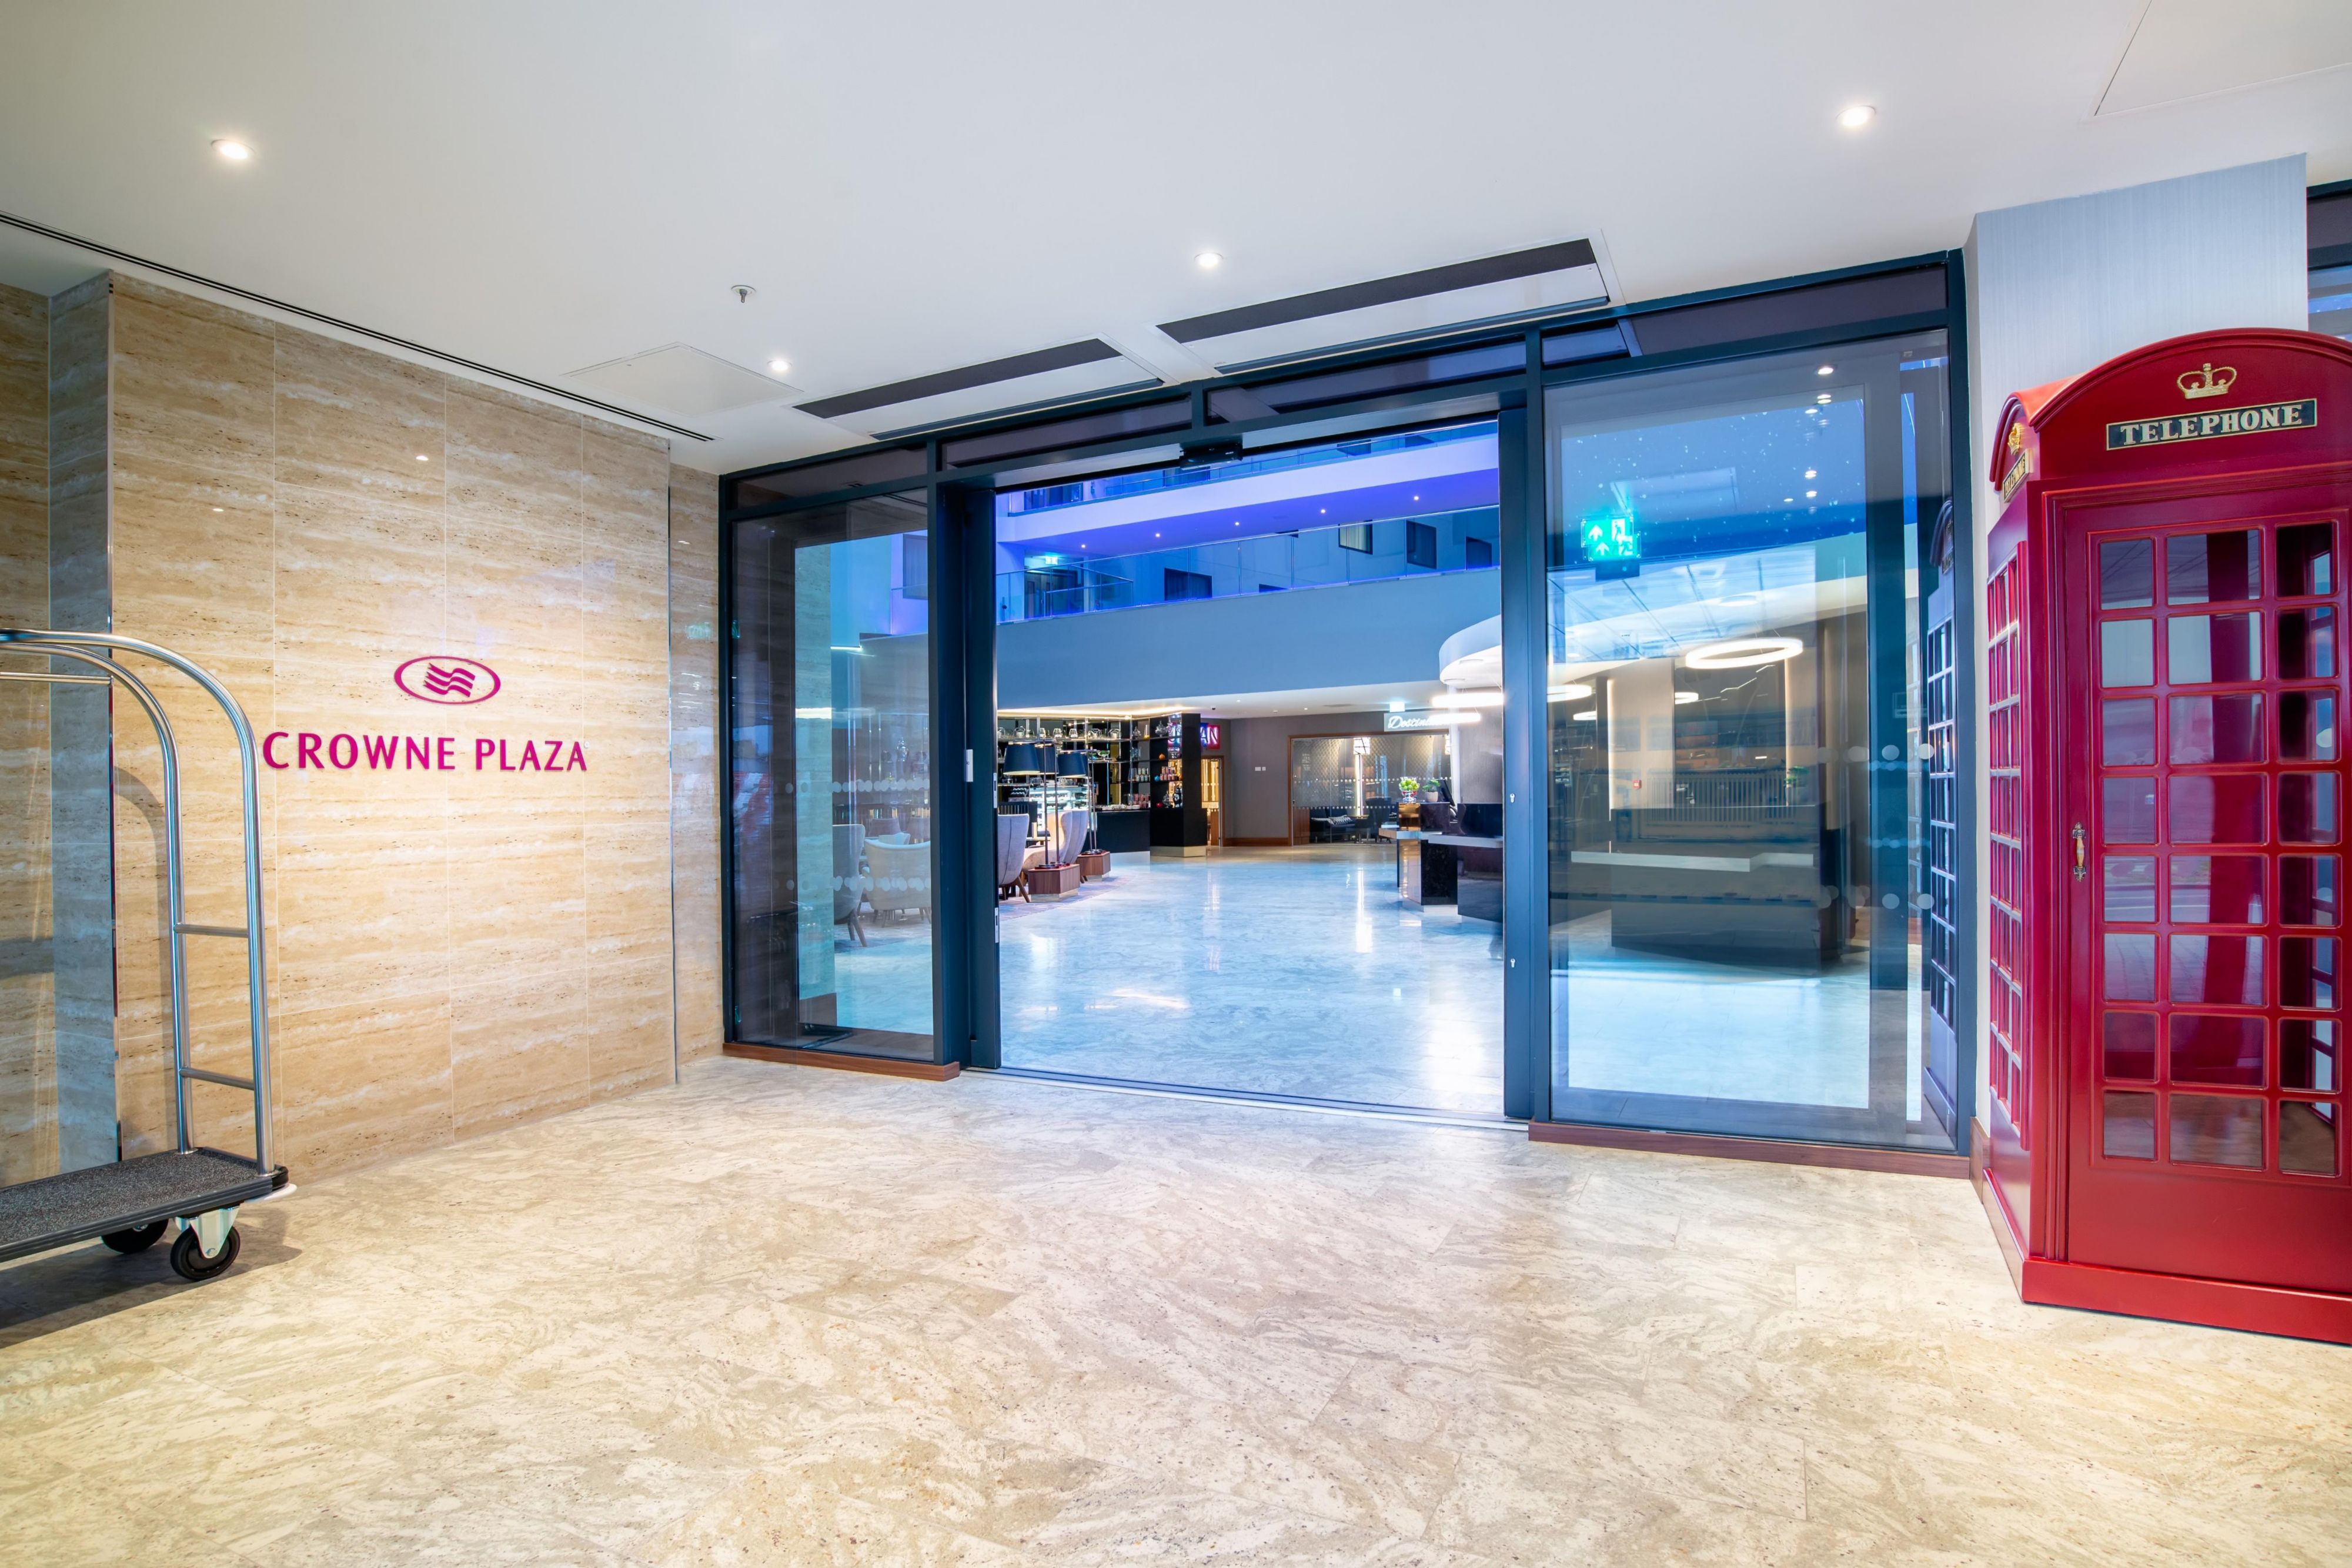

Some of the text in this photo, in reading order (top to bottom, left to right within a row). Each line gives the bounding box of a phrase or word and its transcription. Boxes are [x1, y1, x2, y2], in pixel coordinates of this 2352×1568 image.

[2120, 404, 2303, 445] TELEPHONE
[1388, 715, 1448, 729] Destin
[263, 731, 587, 771] CROWNE PLAZA
